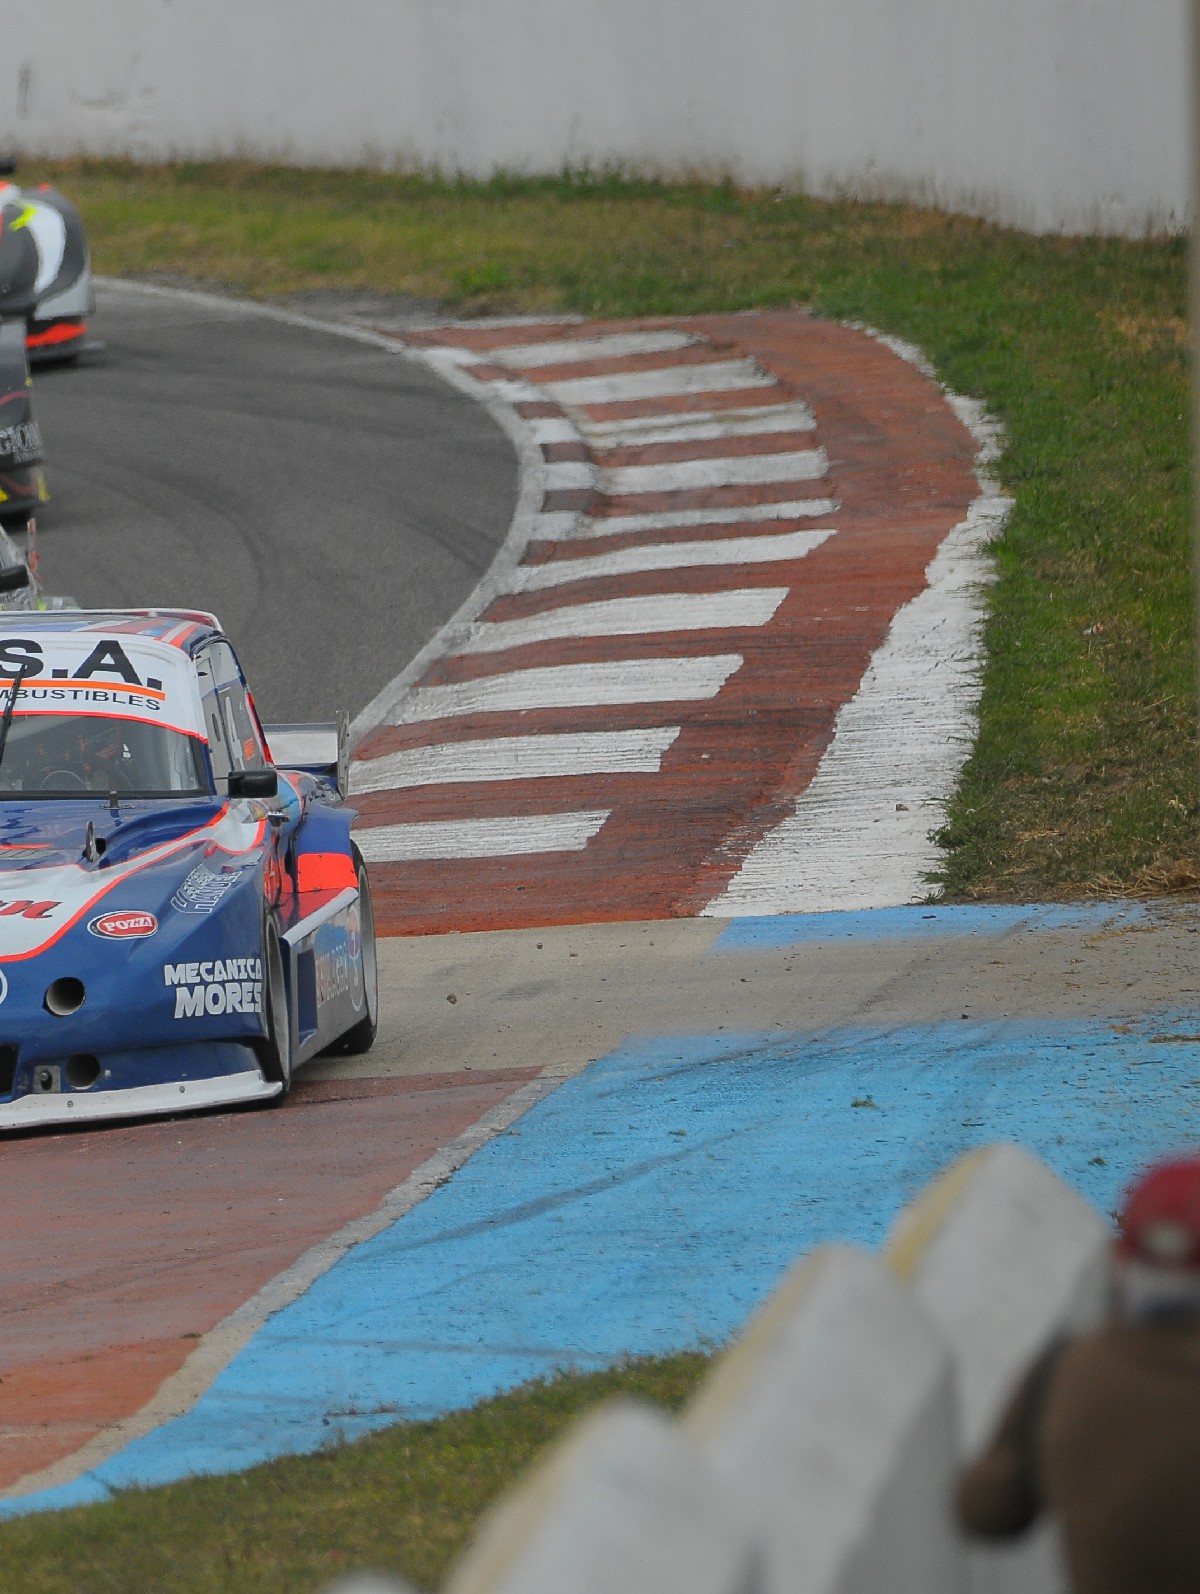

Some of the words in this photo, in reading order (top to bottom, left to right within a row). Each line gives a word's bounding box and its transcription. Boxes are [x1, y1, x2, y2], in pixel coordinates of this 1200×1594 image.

[103, 916, 153, 932] POZZI
[164, 958, 263, 986] MECANICA
[174, 982, 262, 1019] MORES
